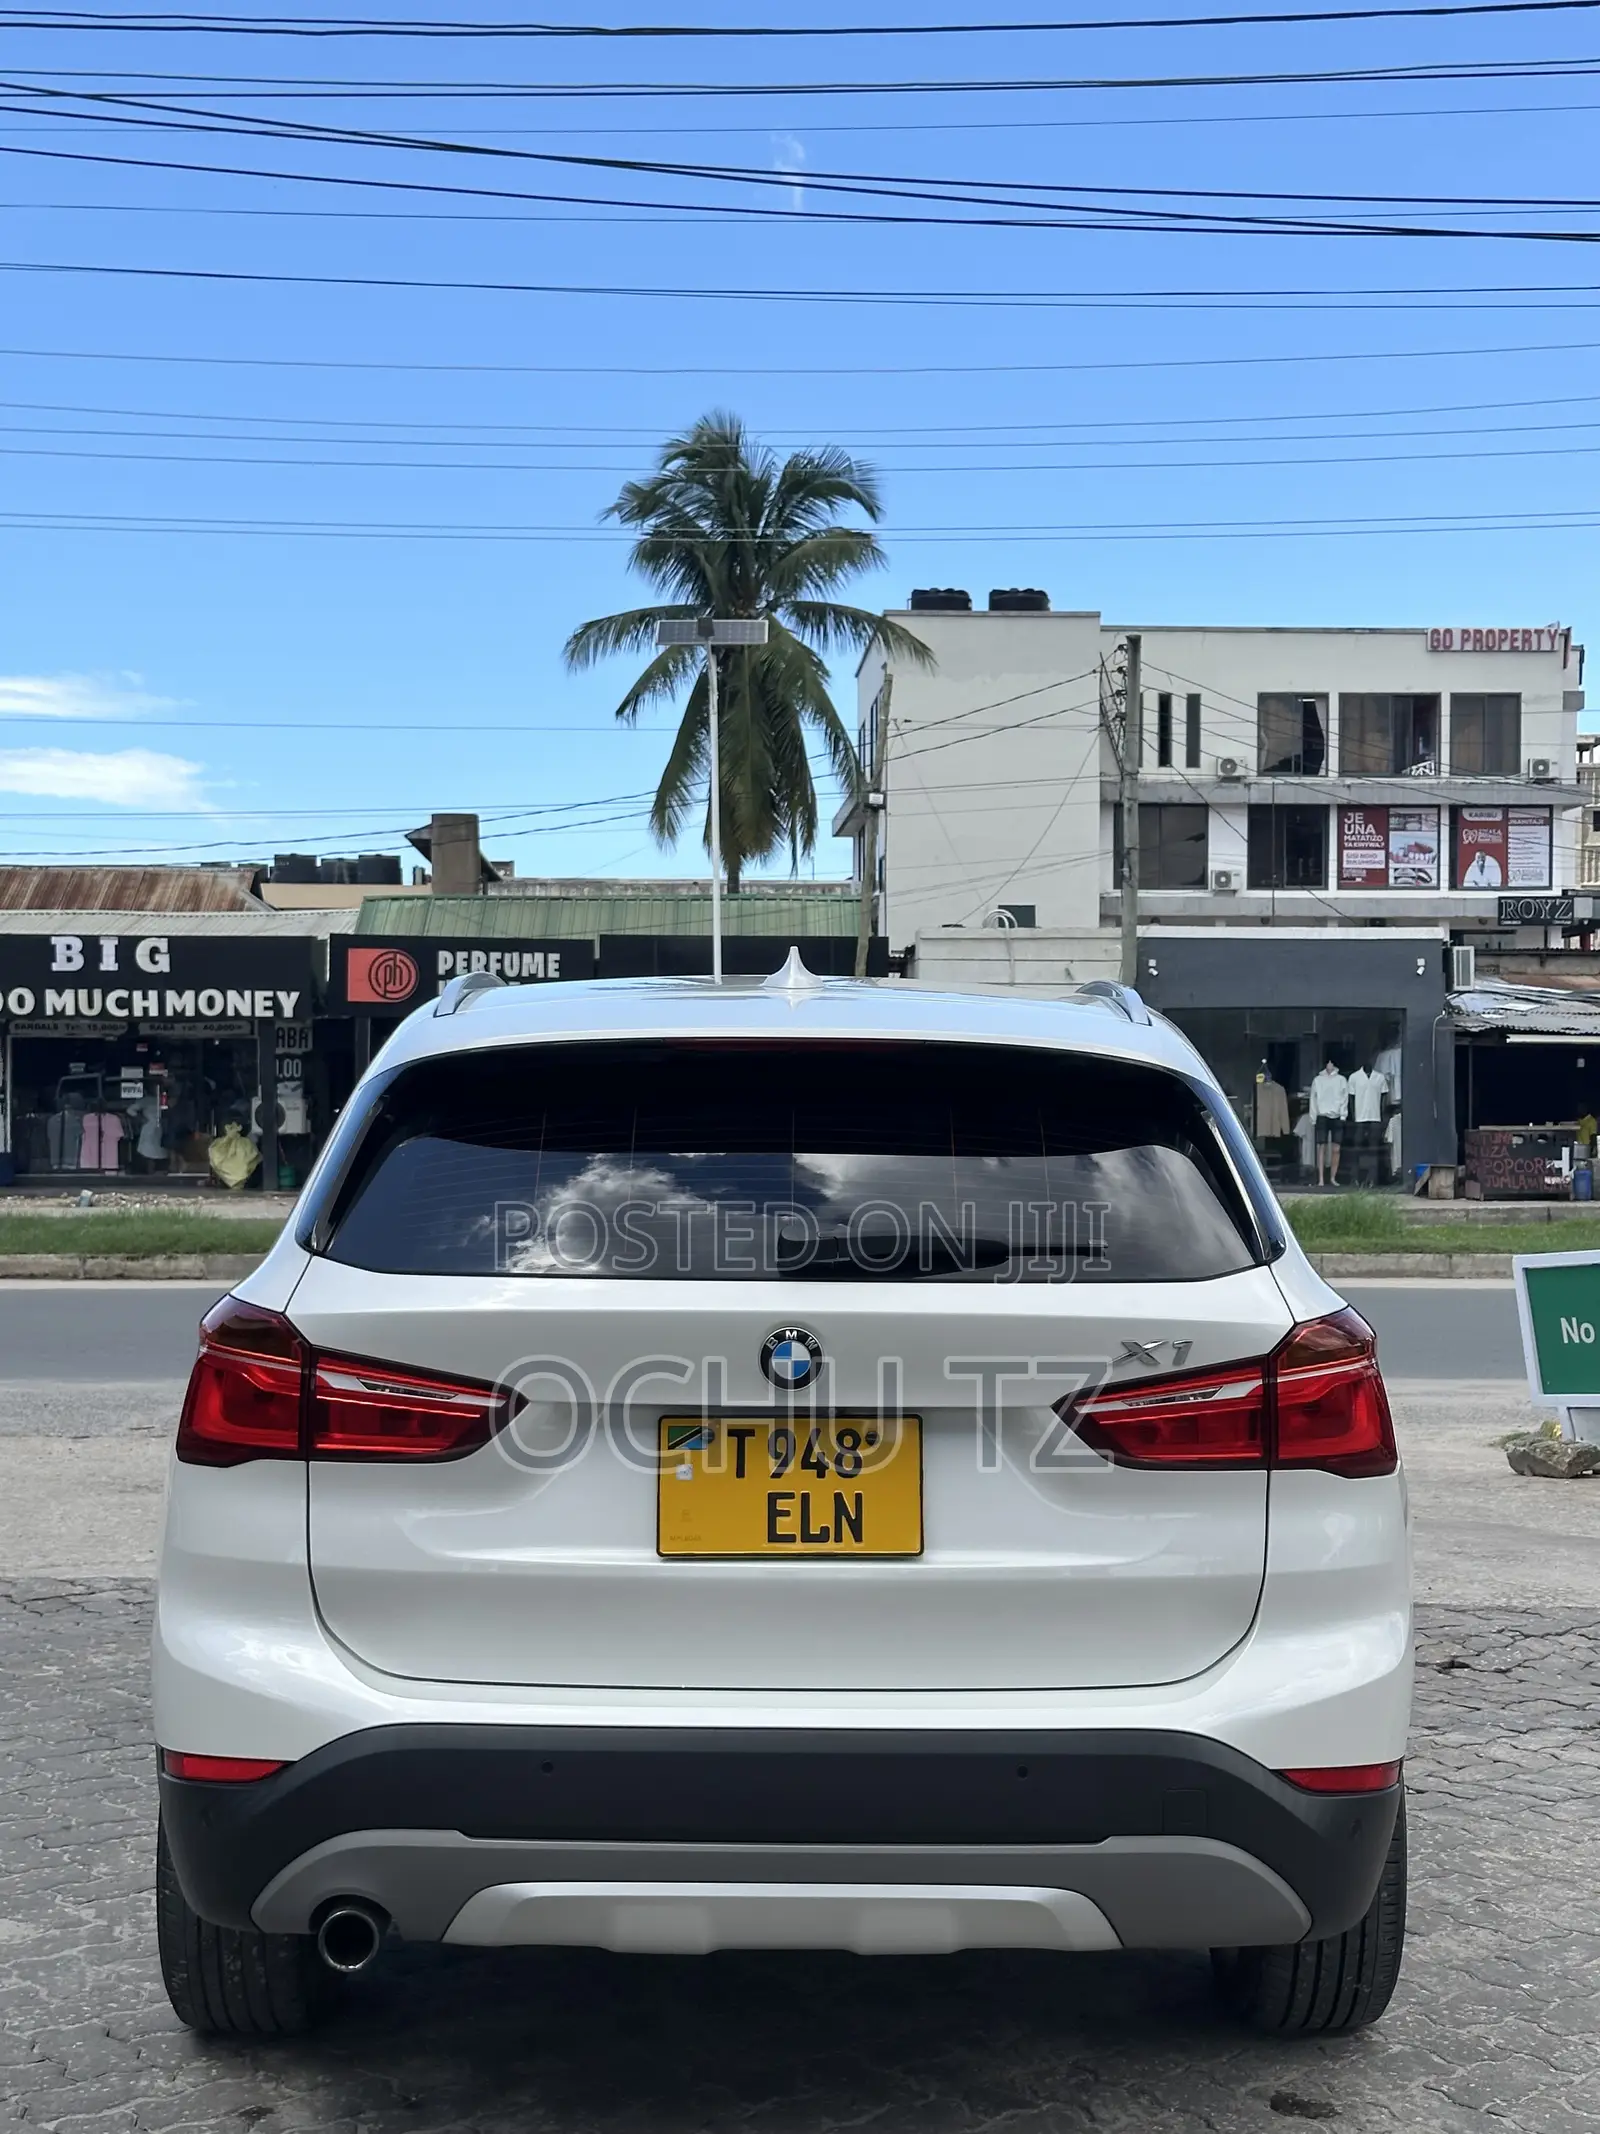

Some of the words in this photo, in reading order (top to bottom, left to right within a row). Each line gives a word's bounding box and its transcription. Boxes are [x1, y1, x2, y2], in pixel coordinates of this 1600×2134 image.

[1460, 628, 1559, 650] PROPERTY
[1344, 812, 1364, 824] JE
[1344, 824, 1376, 835] UNA
[1343, 834, 1384, 842] MATATIZO
[51, 936, 171, 973] BIG
[437, 950, 561, 978] PERFUME
[0, 986, 36, 1016] O
[45, 988, 159, 1017] MUCH
[166, 988, 300, 1018] MONEY
[765, 1329, 819, 1350] BMW
[1560, 1316, 1596, 1344] No
[1111, 1339, 1194, 1366] X1
[727, 1428, 756, 1479] T
[767, 1428, 863, 1479] 948
[767, 1491, 863, 1543] ELN
